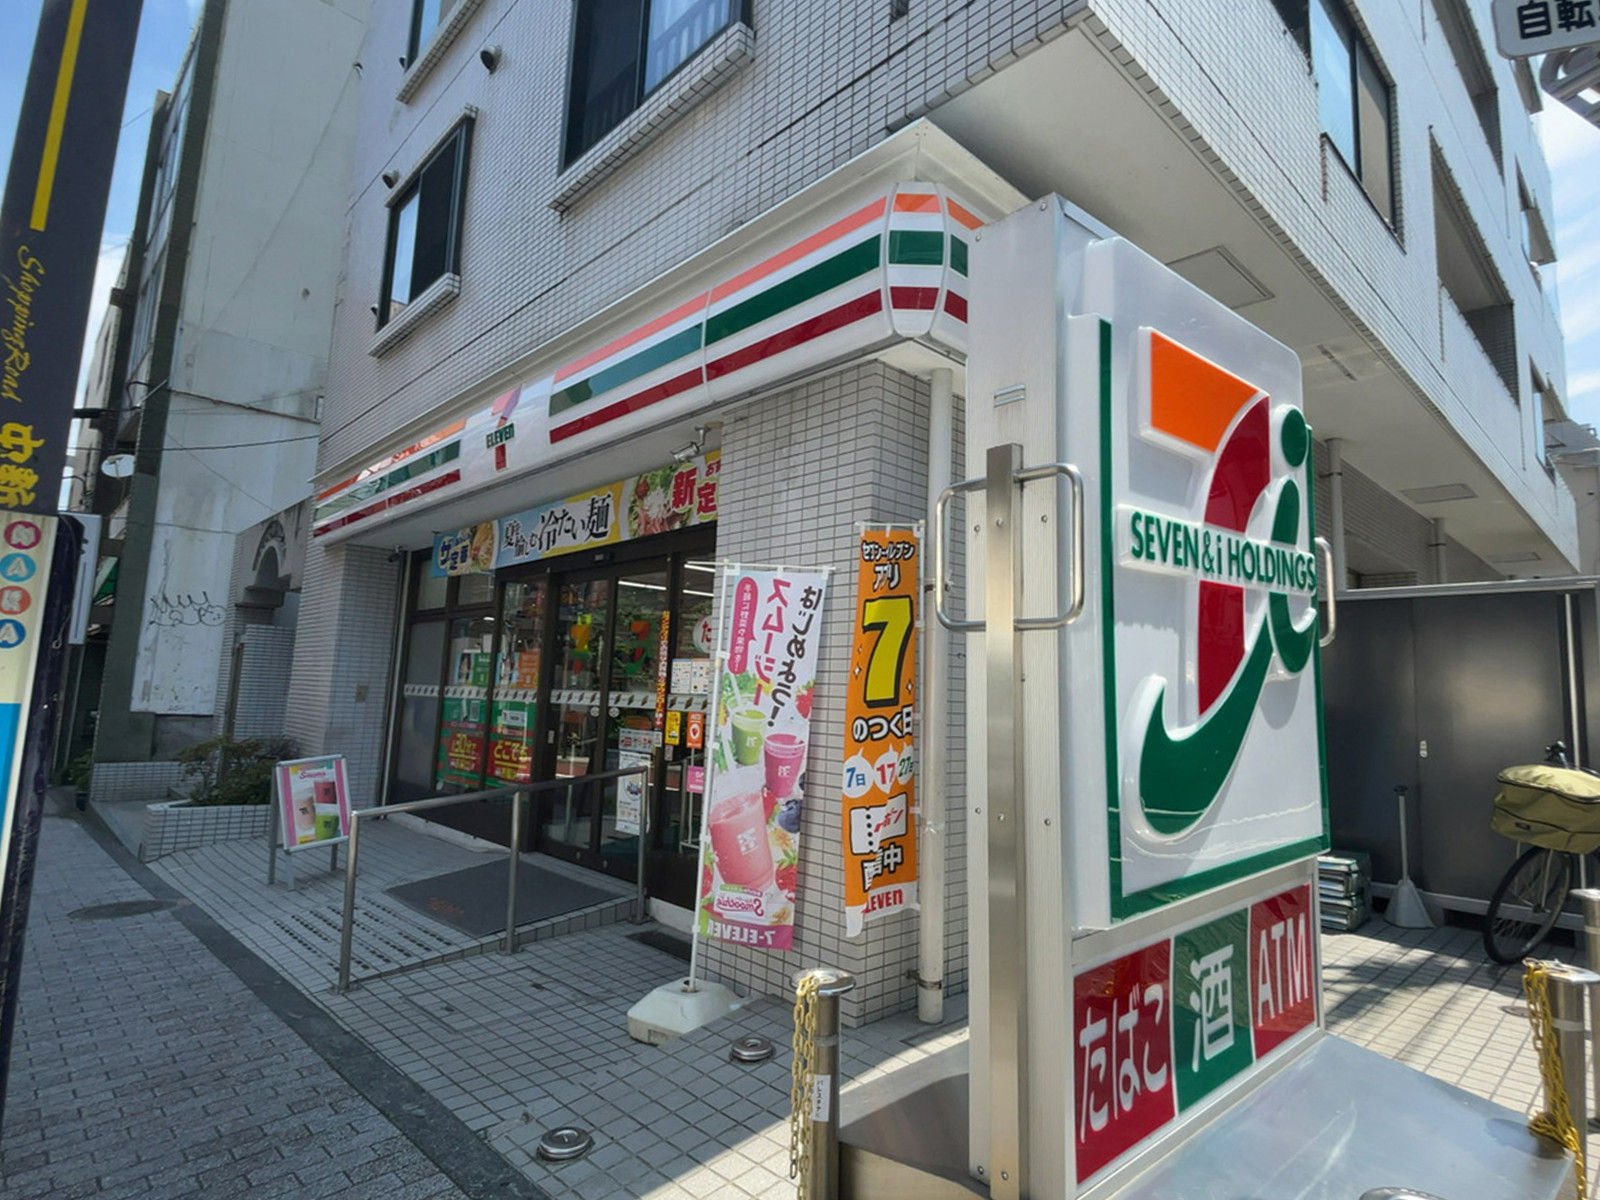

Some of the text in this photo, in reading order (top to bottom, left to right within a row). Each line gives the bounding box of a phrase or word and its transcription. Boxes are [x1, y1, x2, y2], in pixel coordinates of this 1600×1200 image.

[1517, 0, 1600, 39] 自転
[1228, 538, 1316, 591] HOLDINGS
[863, 595, 914, 708] 7
[852, 705, 913, 742] のつく日
[846, 767, 866, 788] 7日
[1189, 944, 1235, 1073] 酒
[1258, 913, 1309, 1027] ATM
[1079, 983, 1168, 1143] たばこ
